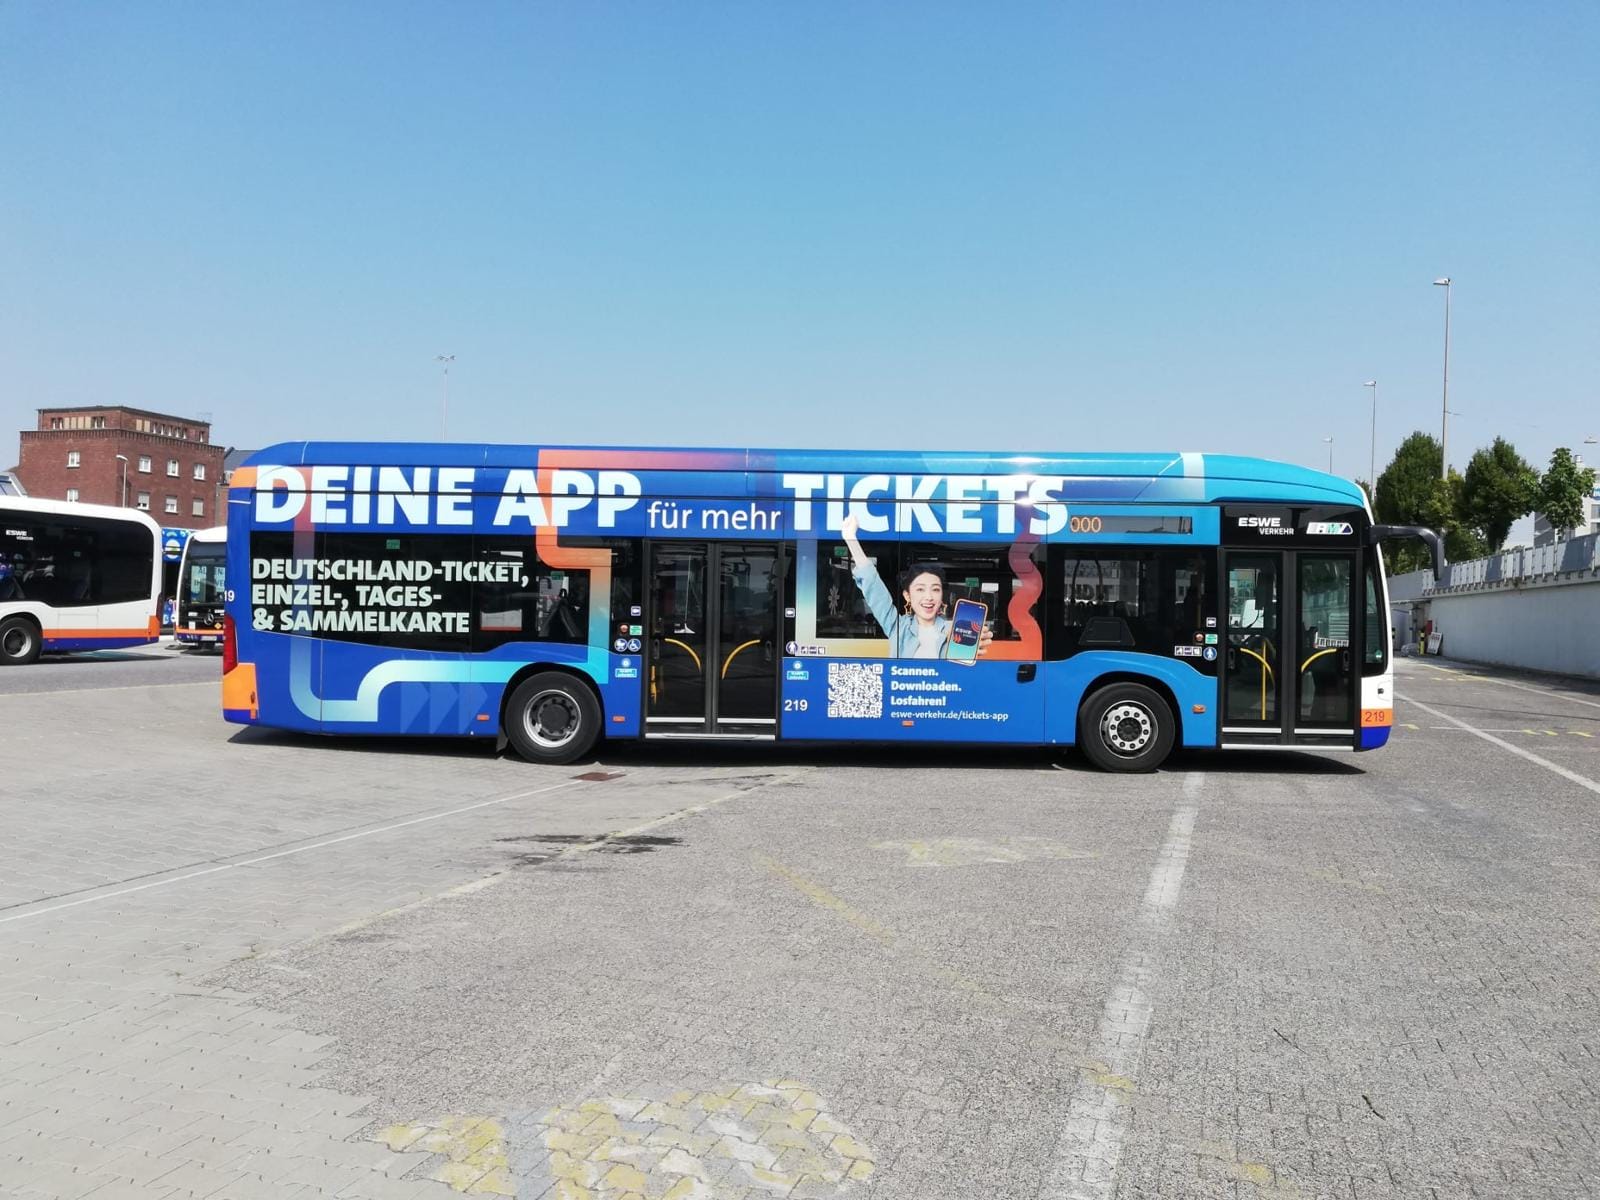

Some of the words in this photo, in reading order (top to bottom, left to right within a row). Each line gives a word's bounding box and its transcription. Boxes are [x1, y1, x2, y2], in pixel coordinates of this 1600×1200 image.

[256, 465, 475, 525] DEINE
[493, 469, 642, 528] APP
[647, 501, 692, 529] für
[702, 503, 781, 530] mehr
[783, 473, 1068, 535] TICKETS
[1238, 517, 1281, 527] ESWE
[6, 529, 28, 537] ESWE
[252, 558, 529, 587] DEUTSCHLAND-TICKET,
[224, 590, 235, 602] 19
[252, 584, 349, 610] EINZEL-,
[355, 585, 442, 607] TAGES-
[252, 607, 274, 631] &
[280, 610, 470, 633] SAMMELKARTE
[891, 666, 939, 676] Scannen.
[891, 681, 962, 692] Downloaden.
[784, 699, 808, 711] 219
[891, 696, 946, 706] Losfahren!
[891, 711, 1009, 722] eswe-verkehr.de/tickets-app
[1365, 711, 1385, 722] 219
